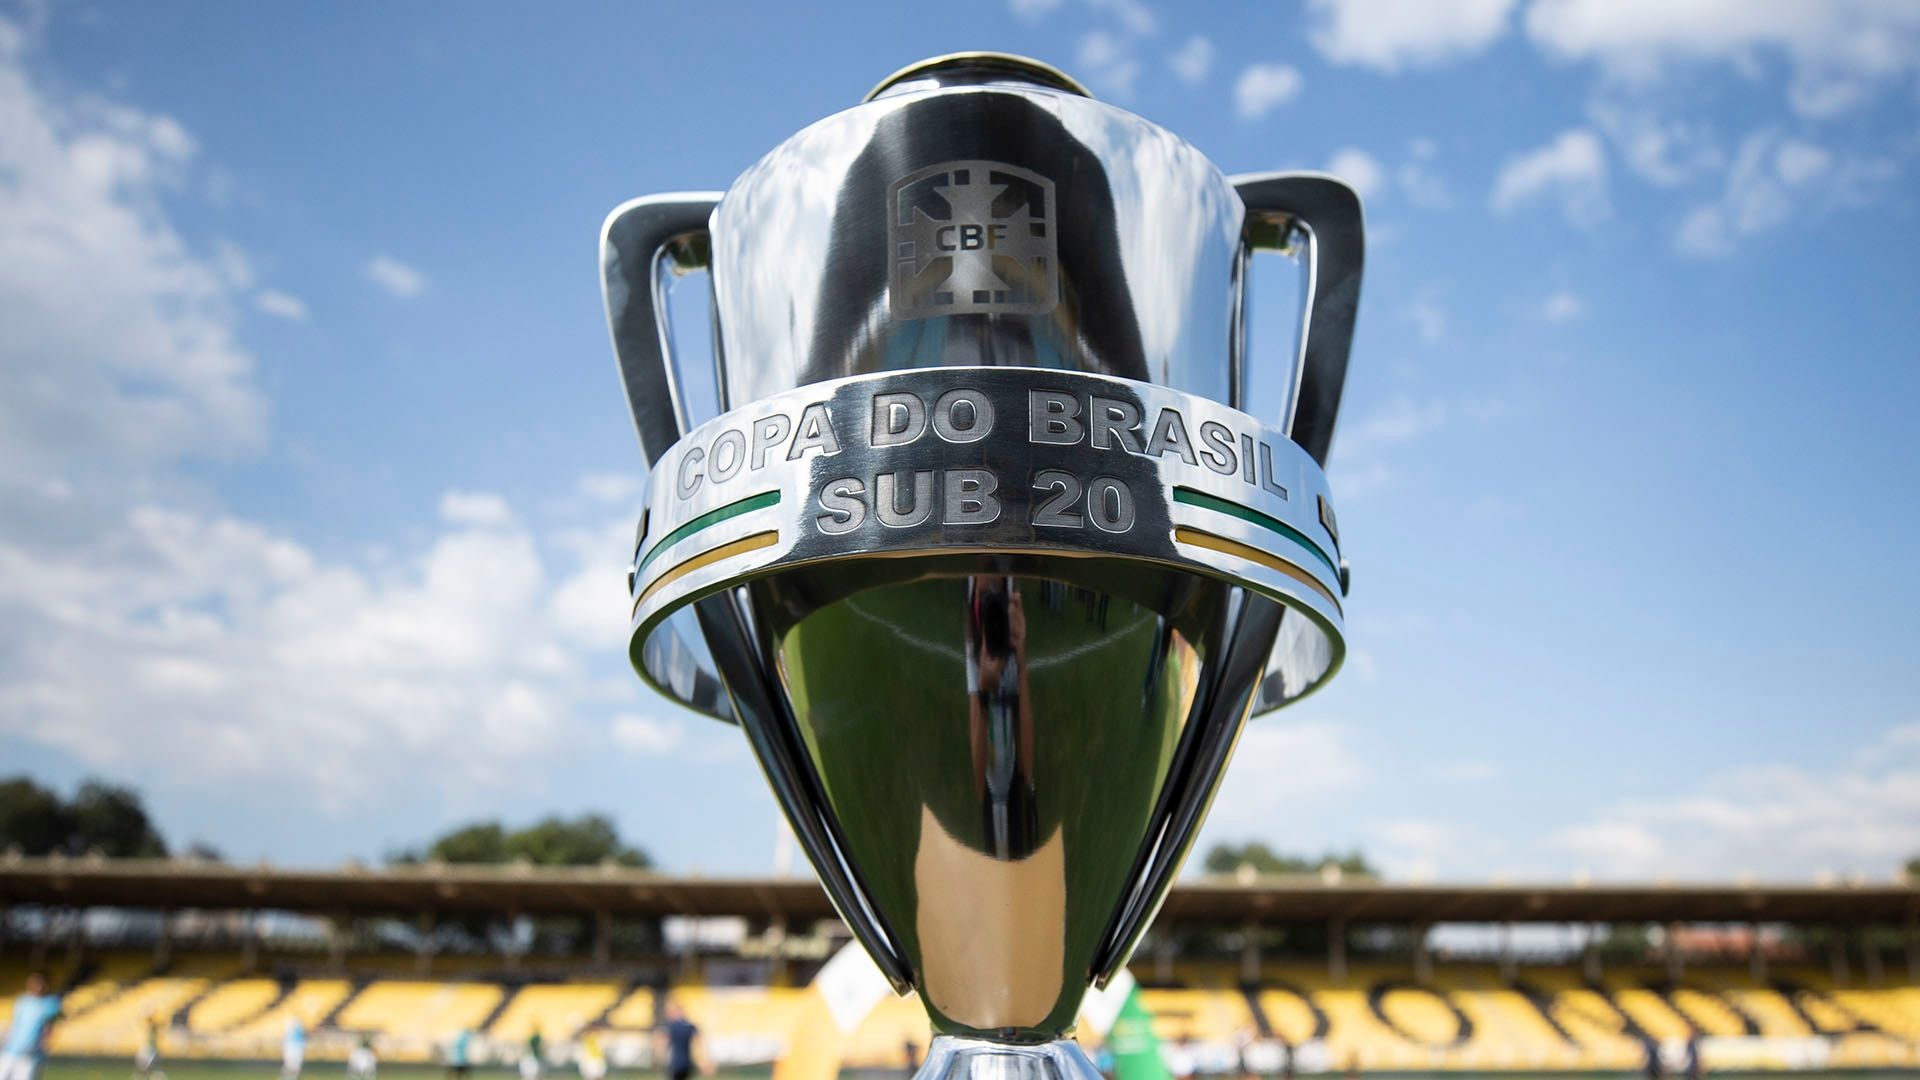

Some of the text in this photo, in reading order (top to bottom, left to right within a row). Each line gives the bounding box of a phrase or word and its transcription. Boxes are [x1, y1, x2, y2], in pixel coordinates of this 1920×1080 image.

[936, 224, 1008, 251] CBF
[677, 388, 1289, 501] COPA DO BRASIL
[816, 469, 1138, 536] SUB 20
[1138, 972, 1902, 1050] DONDA
